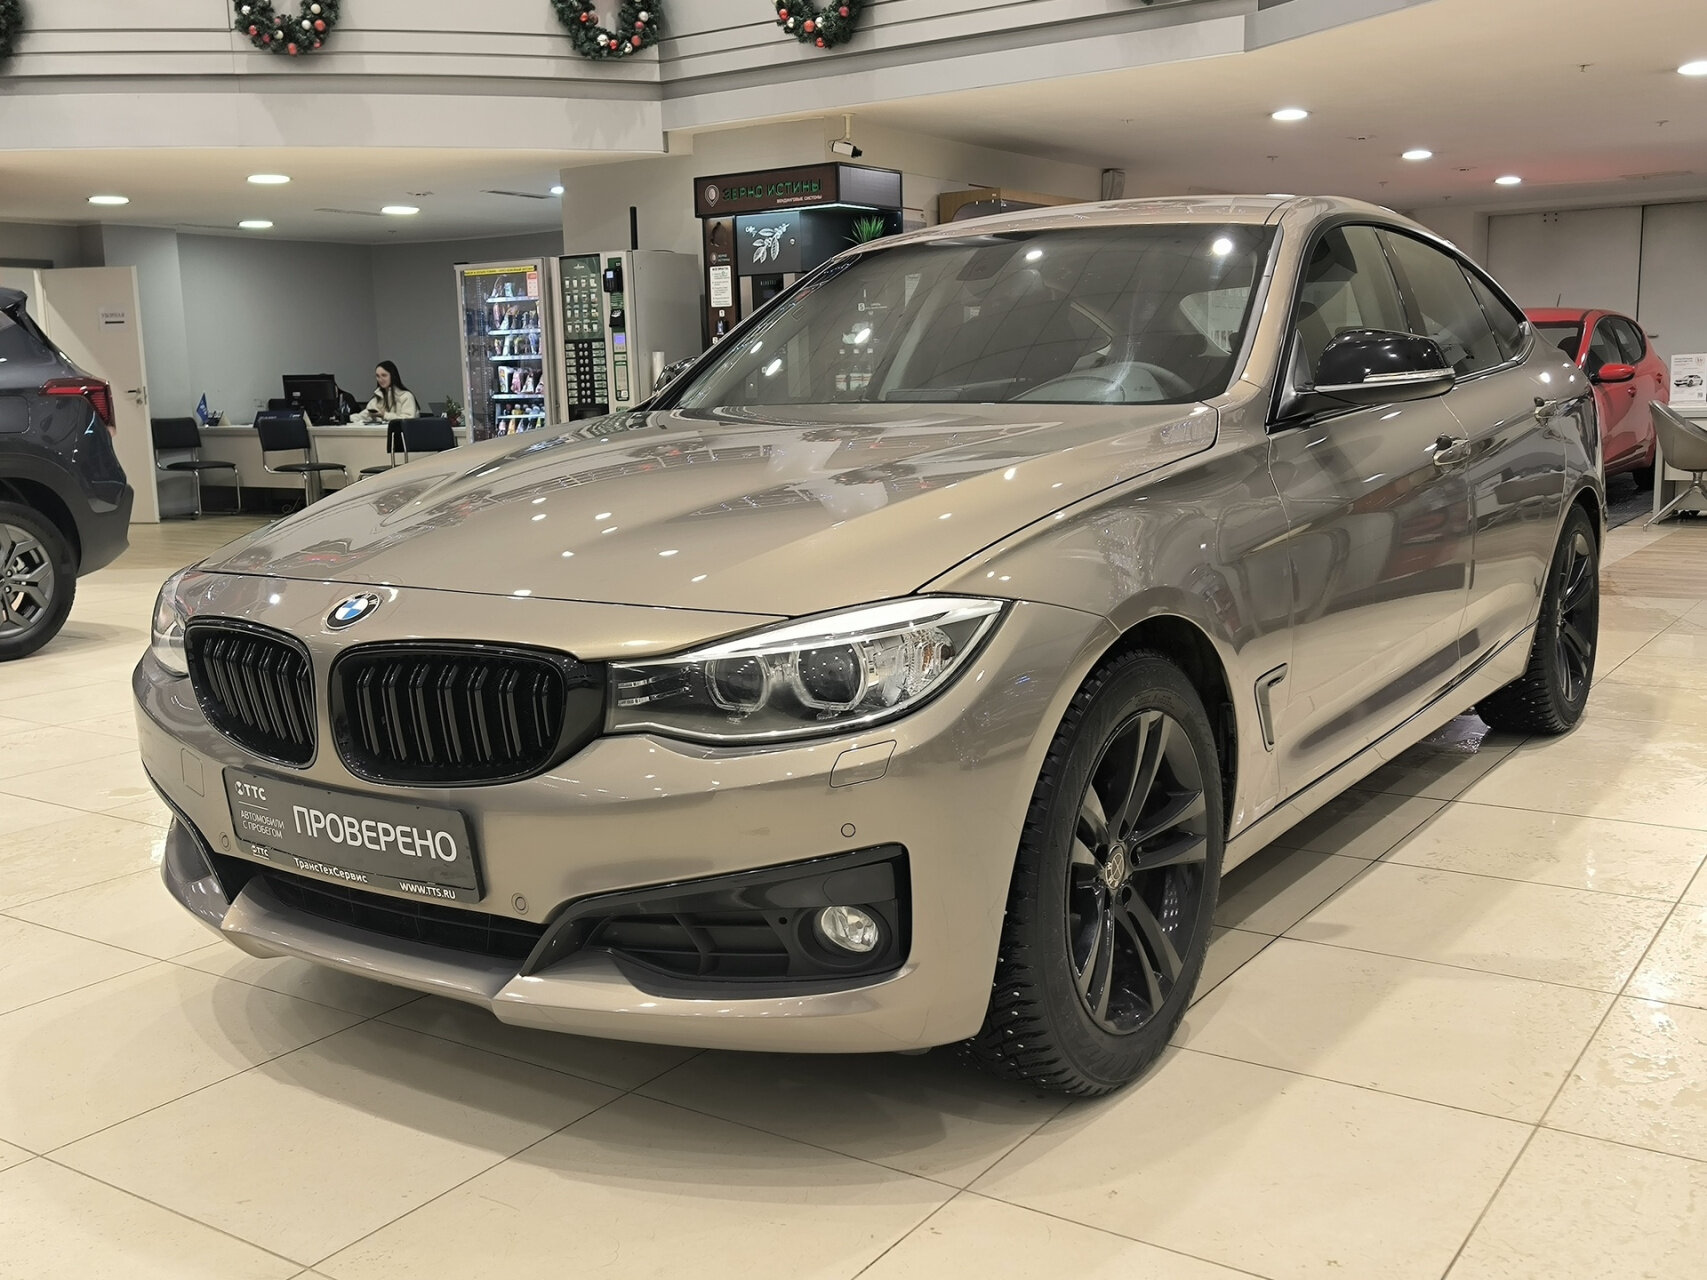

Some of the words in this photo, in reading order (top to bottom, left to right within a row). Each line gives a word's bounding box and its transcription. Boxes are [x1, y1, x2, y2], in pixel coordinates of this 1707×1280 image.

[723, 186, 763, 201] ЗЕРНО
[767, 179, 822, 197] ИСТИНЫ
[244, 784, 267, 801] ТТС
[240, 809, 285, 830] АВТОМОБИЛИ
[242, 820, 248, 829] С
[248, 821, 283, 840] ПРОБЕГОМ
[292, 805, 457, 862] ПРОВЕРЕНО
[294, 857, 368, 883] ТрансТехСервис
[399, 882, 456, 900] WWW.TTS.RU
